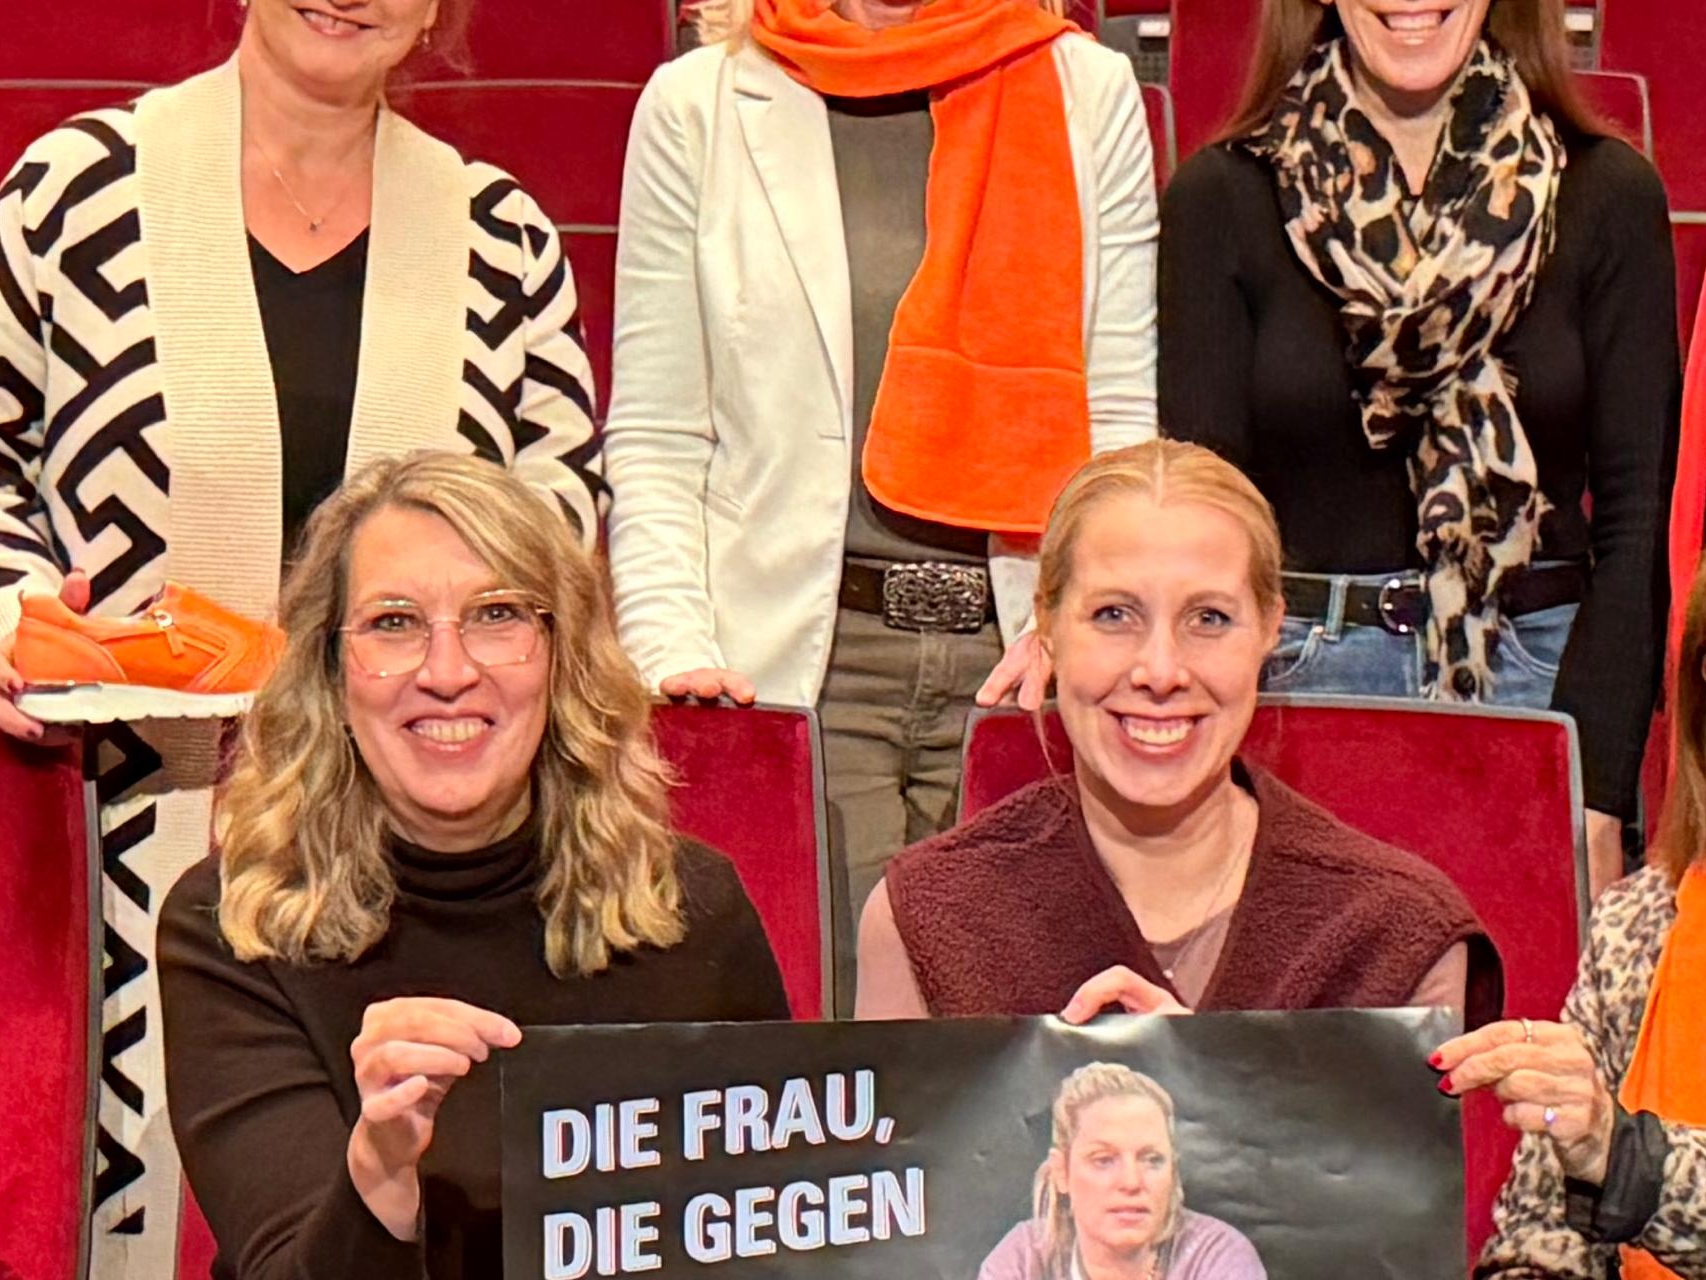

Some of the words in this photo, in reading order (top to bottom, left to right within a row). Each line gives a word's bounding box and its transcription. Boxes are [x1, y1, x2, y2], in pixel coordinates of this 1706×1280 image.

[542, 1097, 662, 1179] DIE
[682, 1069, 896, 1161] FRAU,
[683, 1166, 926, 1264] GEGEN
